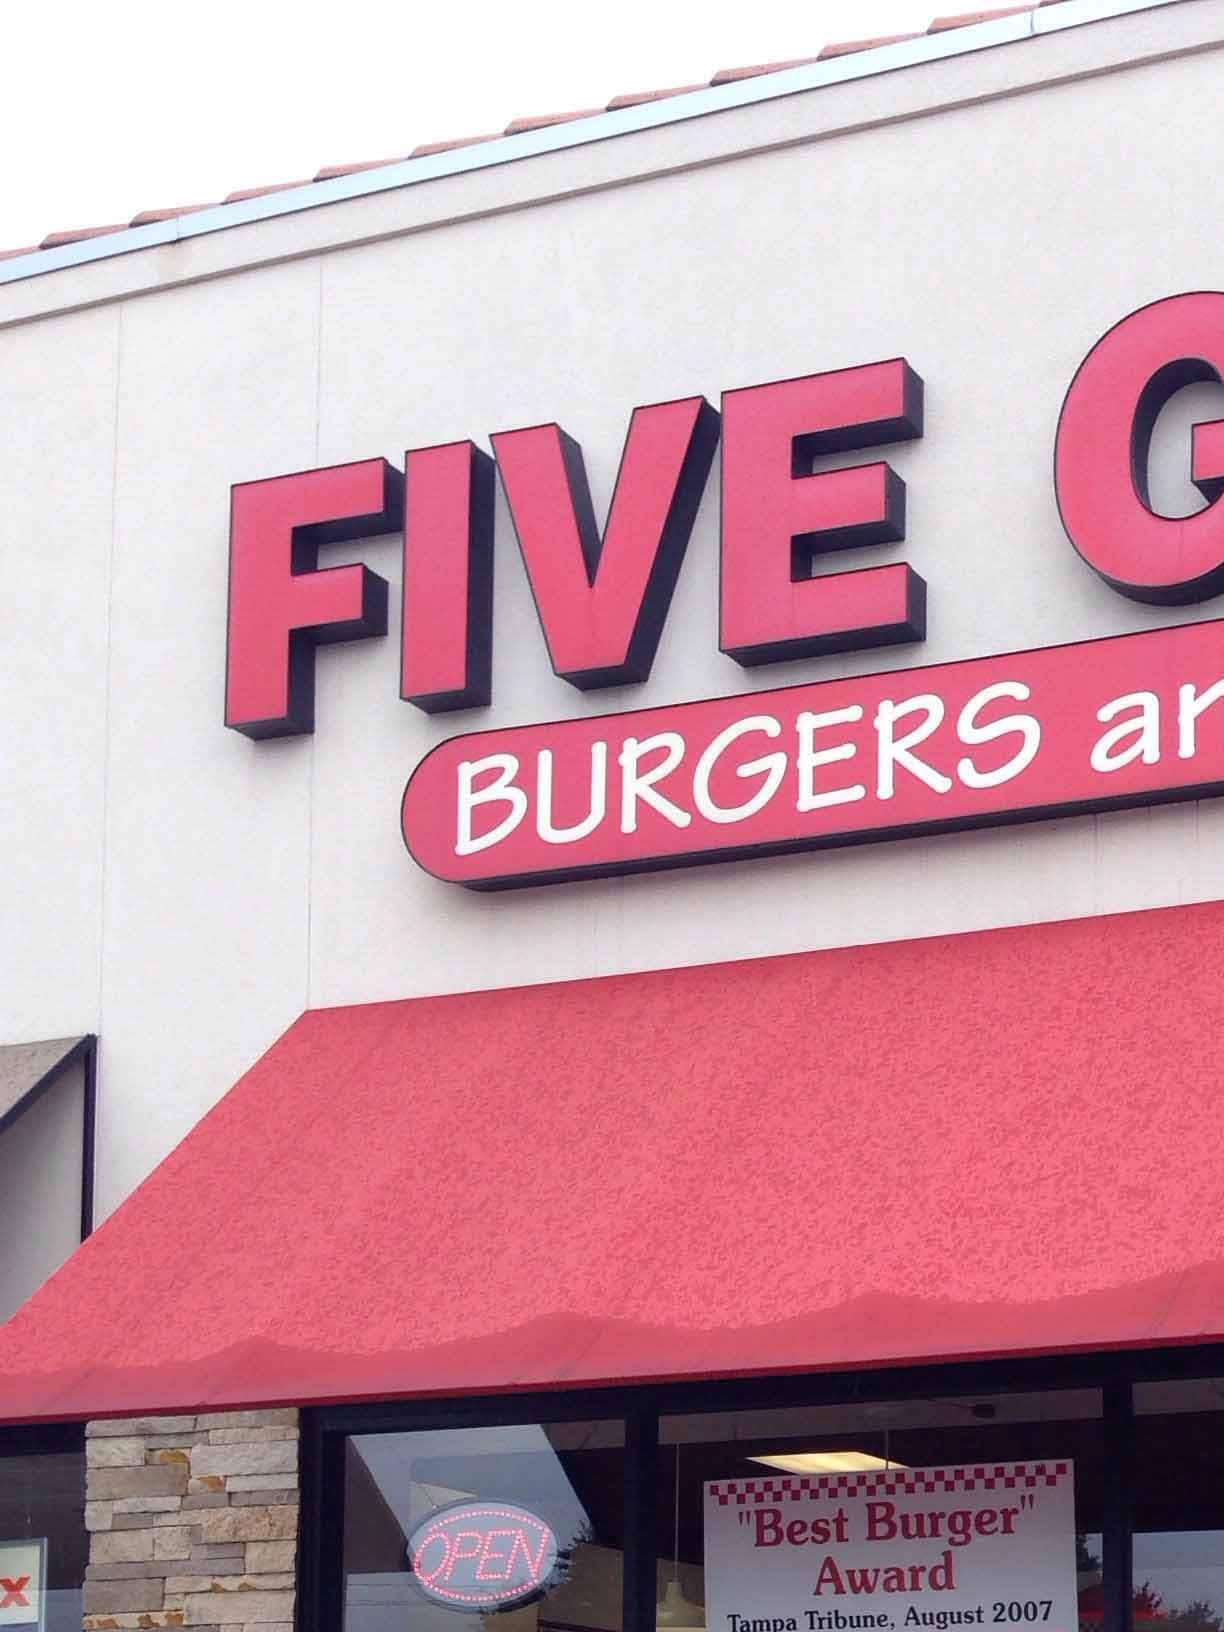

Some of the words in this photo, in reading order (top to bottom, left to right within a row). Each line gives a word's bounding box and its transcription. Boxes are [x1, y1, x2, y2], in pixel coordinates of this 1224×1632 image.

[224, 357, 927, 742] FIVE
[454, 681, 1041, 857] BURGERS
[738, 1506, 849, 1547] "Best
[865, 1494, 1035, 1547] Burger"
[414, 1526, 551, 1584] OPEN
[813, 1550, 956, 1596] Award
[804, 1609, 896, 1631] Tribune,
[904, 1605, 985, 1630] August
[992, 1600, 1053, 1623] 2007
